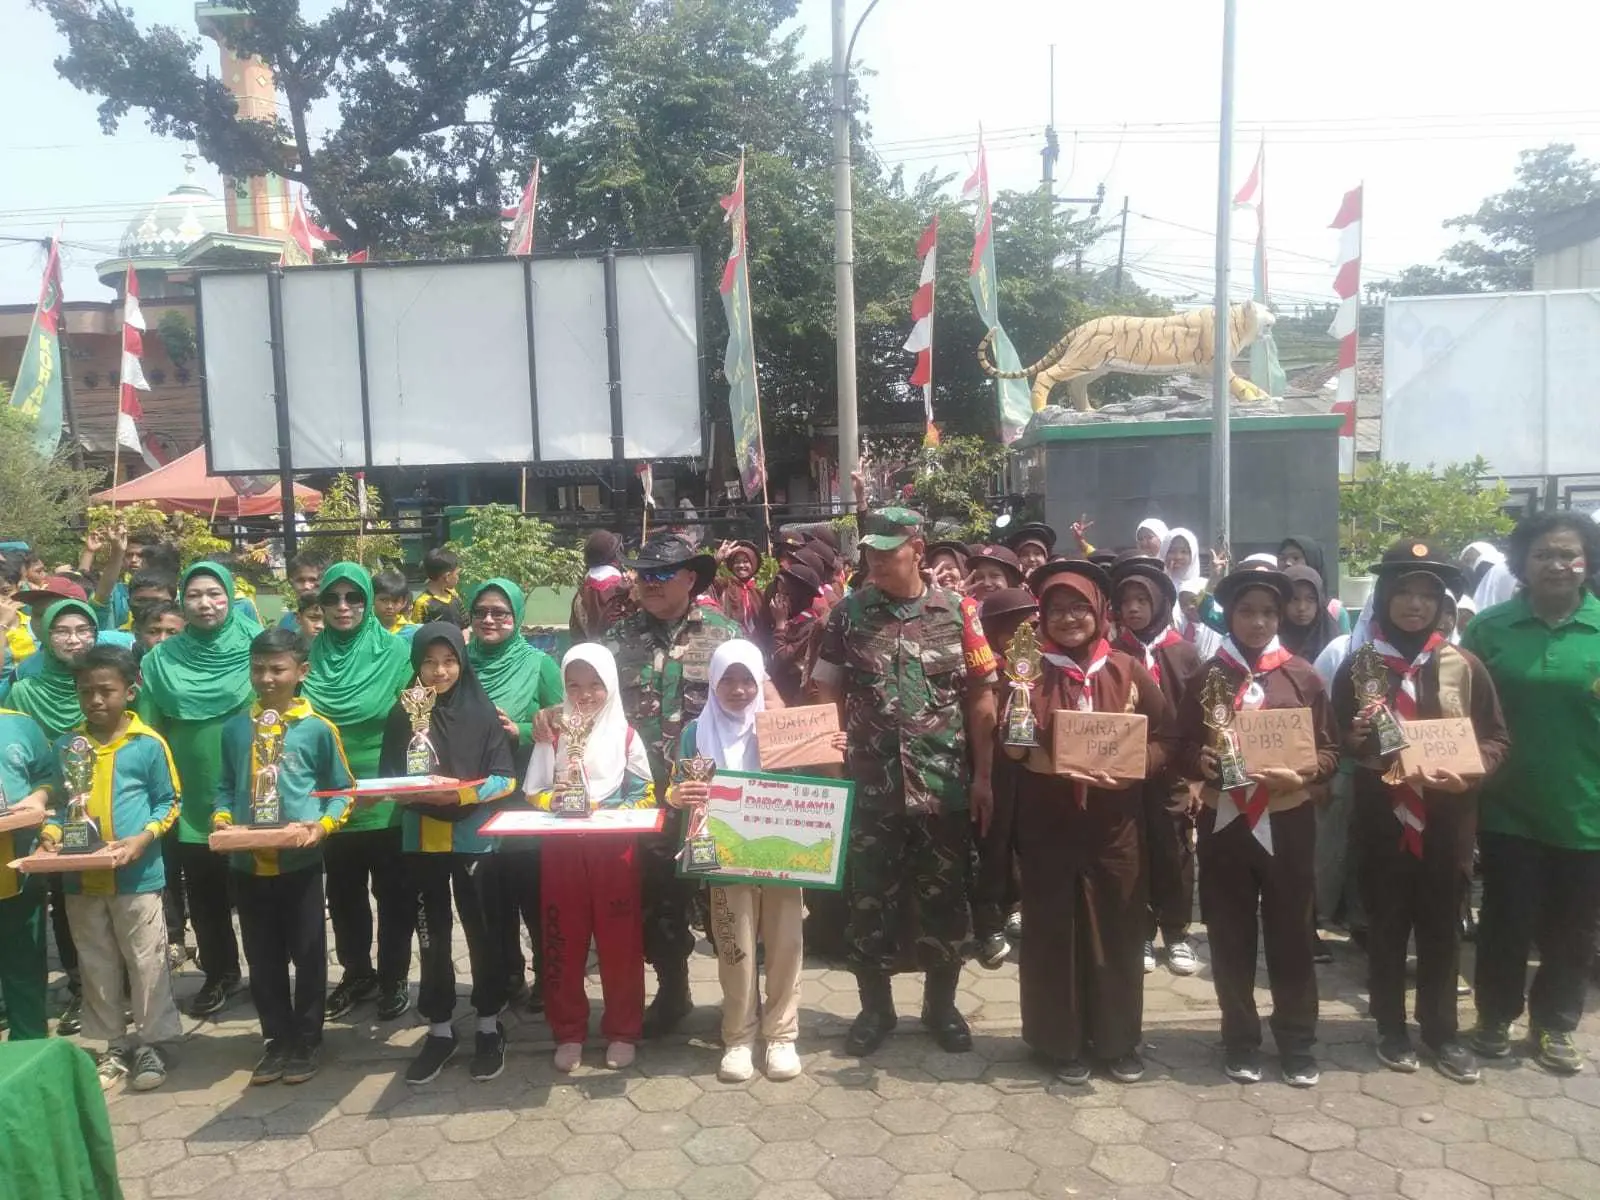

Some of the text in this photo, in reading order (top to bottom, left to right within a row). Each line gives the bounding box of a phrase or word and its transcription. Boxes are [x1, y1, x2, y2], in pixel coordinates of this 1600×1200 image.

[1063, 718, 1131, 736] JUARA 1
[1290, 713, 1302, 729] 2
[1406, 724, 1453, 740] UARA
[1455, 722, 1467, 737] 3
[1087, 739, 1120, 756] PBB
[1247, 733, 1284, 749] PBB
[1422, 741, 1459, 757] PBB
[744, 795, 836, 815] DIRGAHAYU
